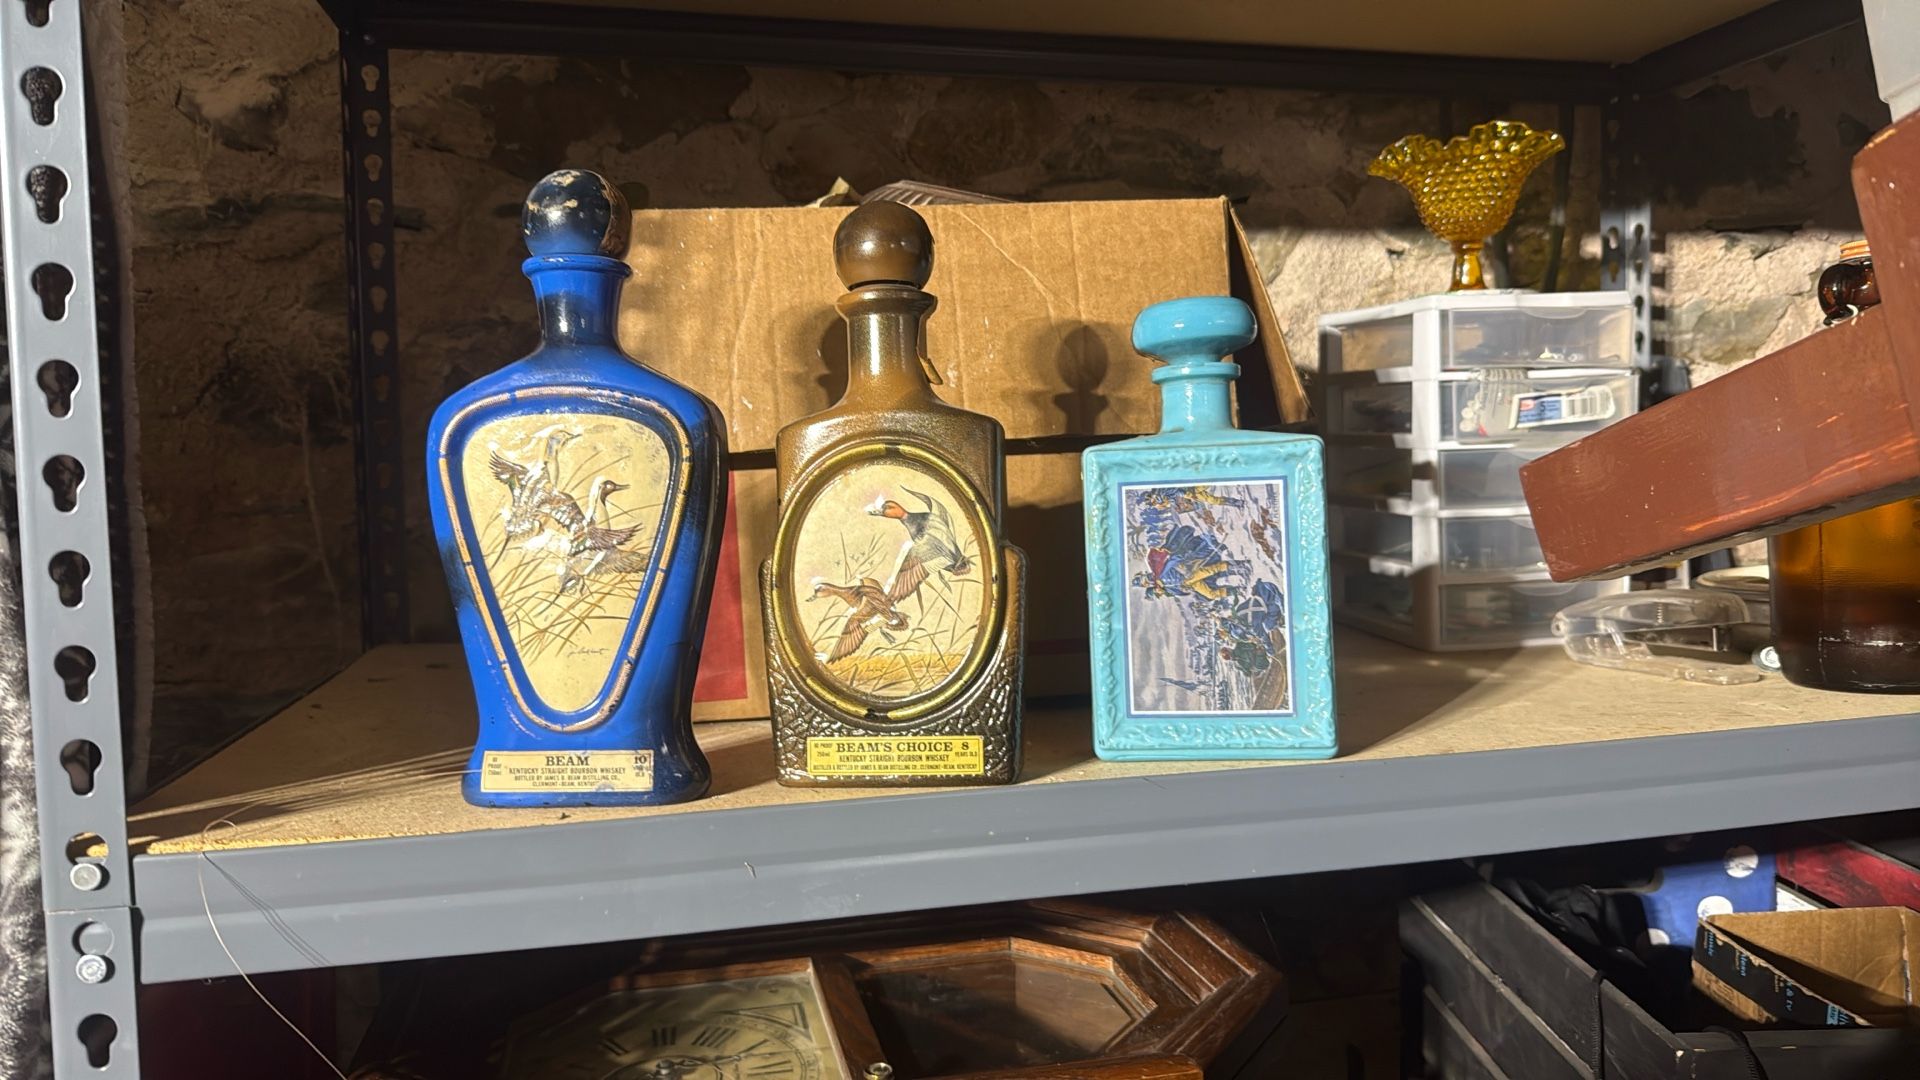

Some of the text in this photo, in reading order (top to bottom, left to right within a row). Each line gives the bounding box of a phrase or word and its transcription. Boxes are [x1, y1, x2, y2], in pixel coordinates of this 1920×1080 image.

[836, 742, 892, 753] BEAM'S
[896, 741, 953, 752] CHOICE
[545, 755, 590, 767] BEAM
[634, 755, 648, 765] 10
[839, 754, 950, 763] KENTUCKY STRAIGHT BOURBON WHISKEY
[508, 767, 539, 775] KENTUCKY
[540, 767, 568, 775] STRAIGHT
